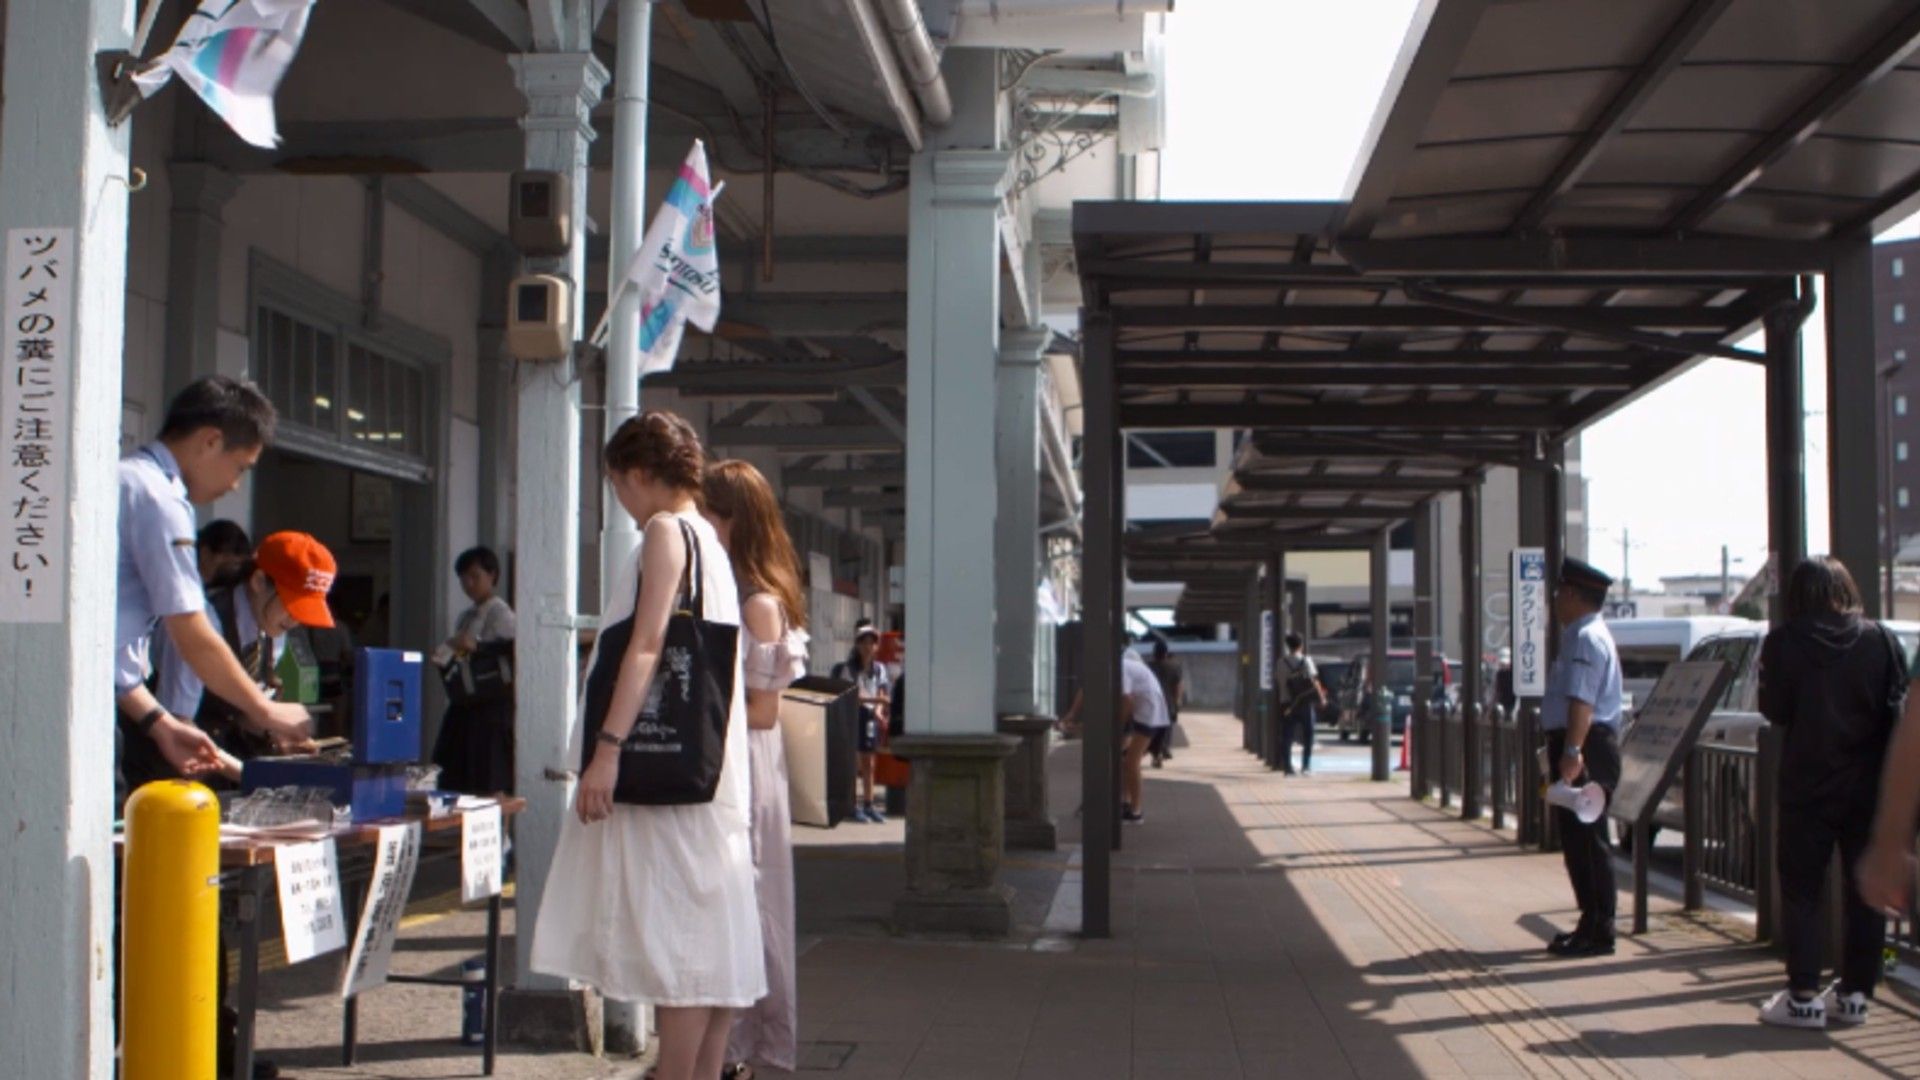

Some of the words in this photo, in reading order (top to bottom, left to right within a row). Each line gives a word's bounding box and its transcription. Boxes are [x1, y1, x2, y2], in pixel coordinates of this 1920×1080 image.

[1521, 583, 1536, 684] タクシーのりば
